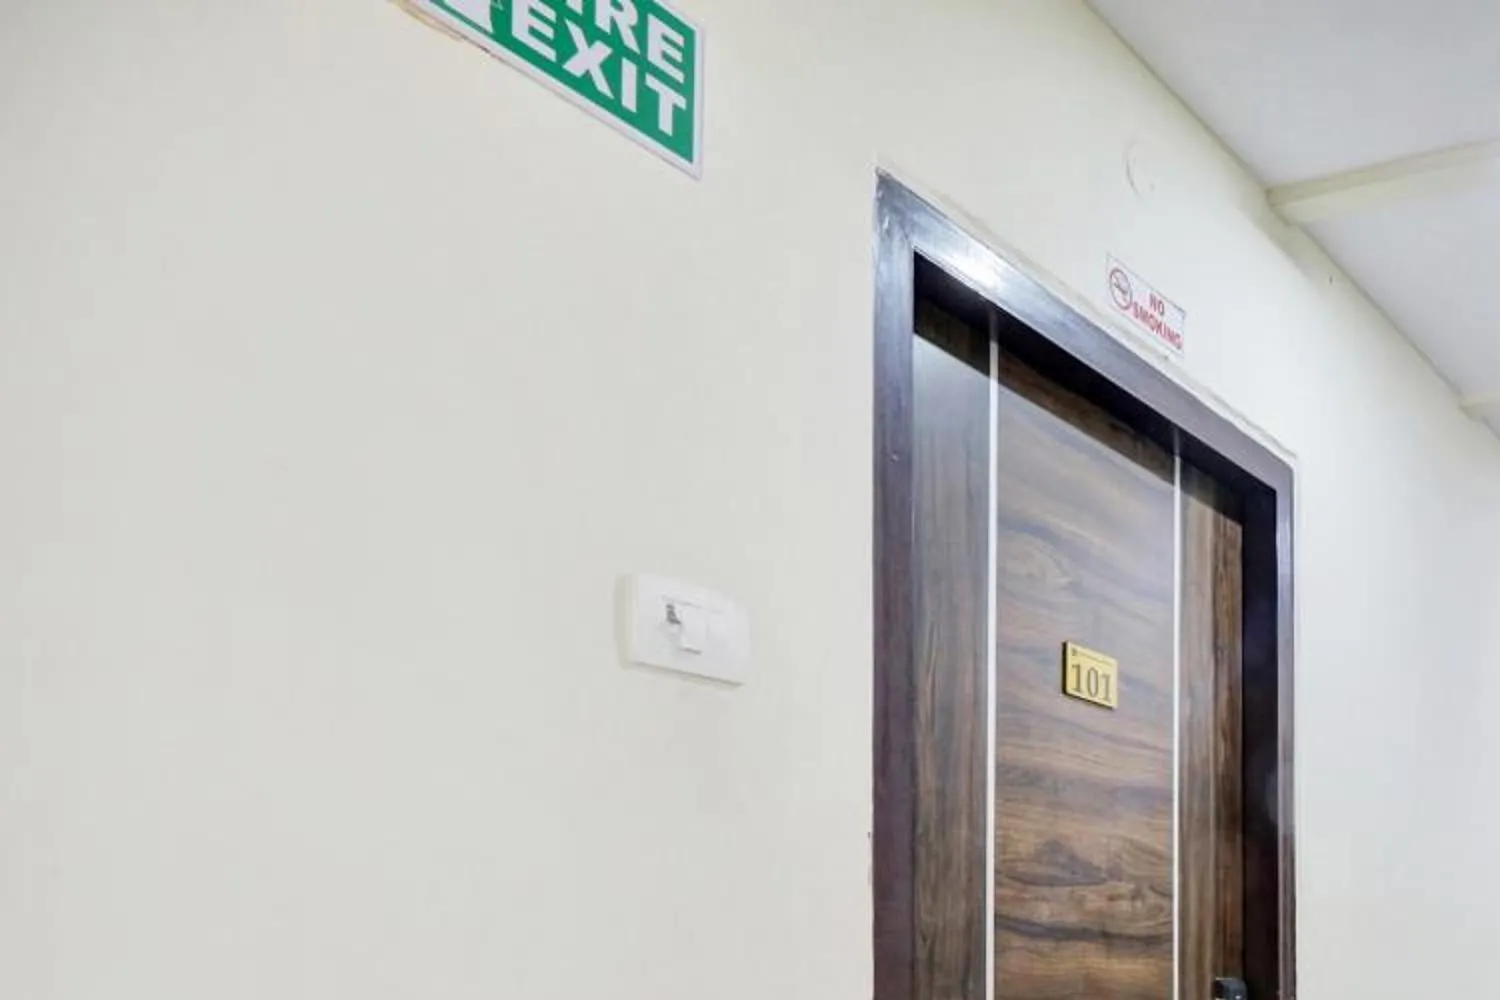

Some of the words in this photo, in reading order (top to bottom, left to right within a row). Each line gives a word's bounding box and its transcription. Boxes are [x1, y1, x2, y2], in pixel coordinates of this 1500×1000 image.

[566, 0, 686, 84] RE
[511, 0, 687, 137] EXIT
[1133, 301, 1182, 350] SMOKING
[1149, 292, 1165, 316] NO
[1071, 663, 1112, 704] 101
